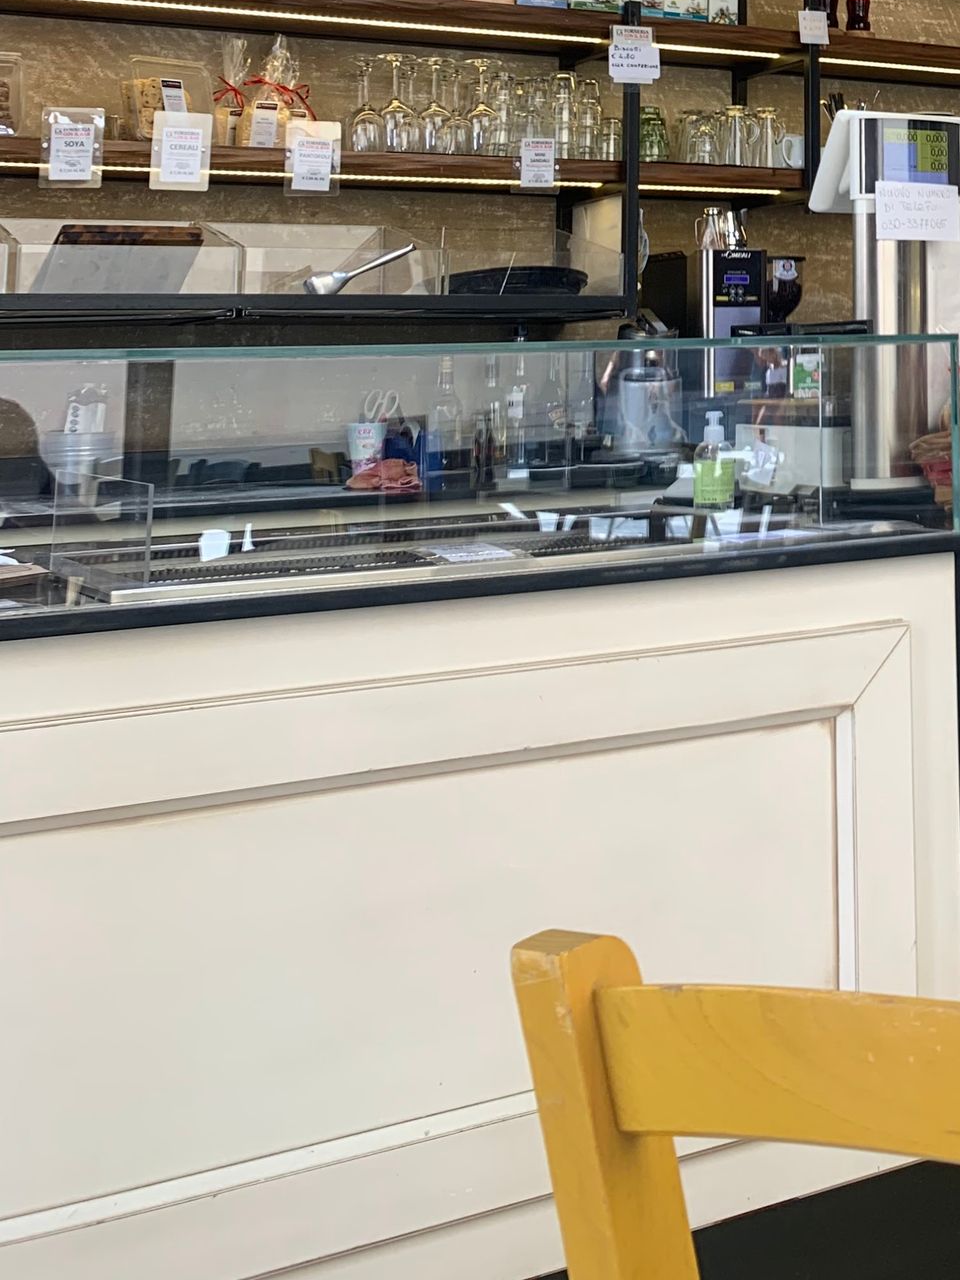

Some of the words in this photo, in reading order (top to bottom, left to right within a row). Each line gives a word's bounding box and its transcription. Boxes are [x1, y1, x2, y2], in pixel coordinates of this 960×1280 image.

[926, 131, 947, 143] 0,000
[64, 140, 85, 148] SOYA
[930, 147, 948, 158] 0,00
[930, 161, 948, 172] 0,00
